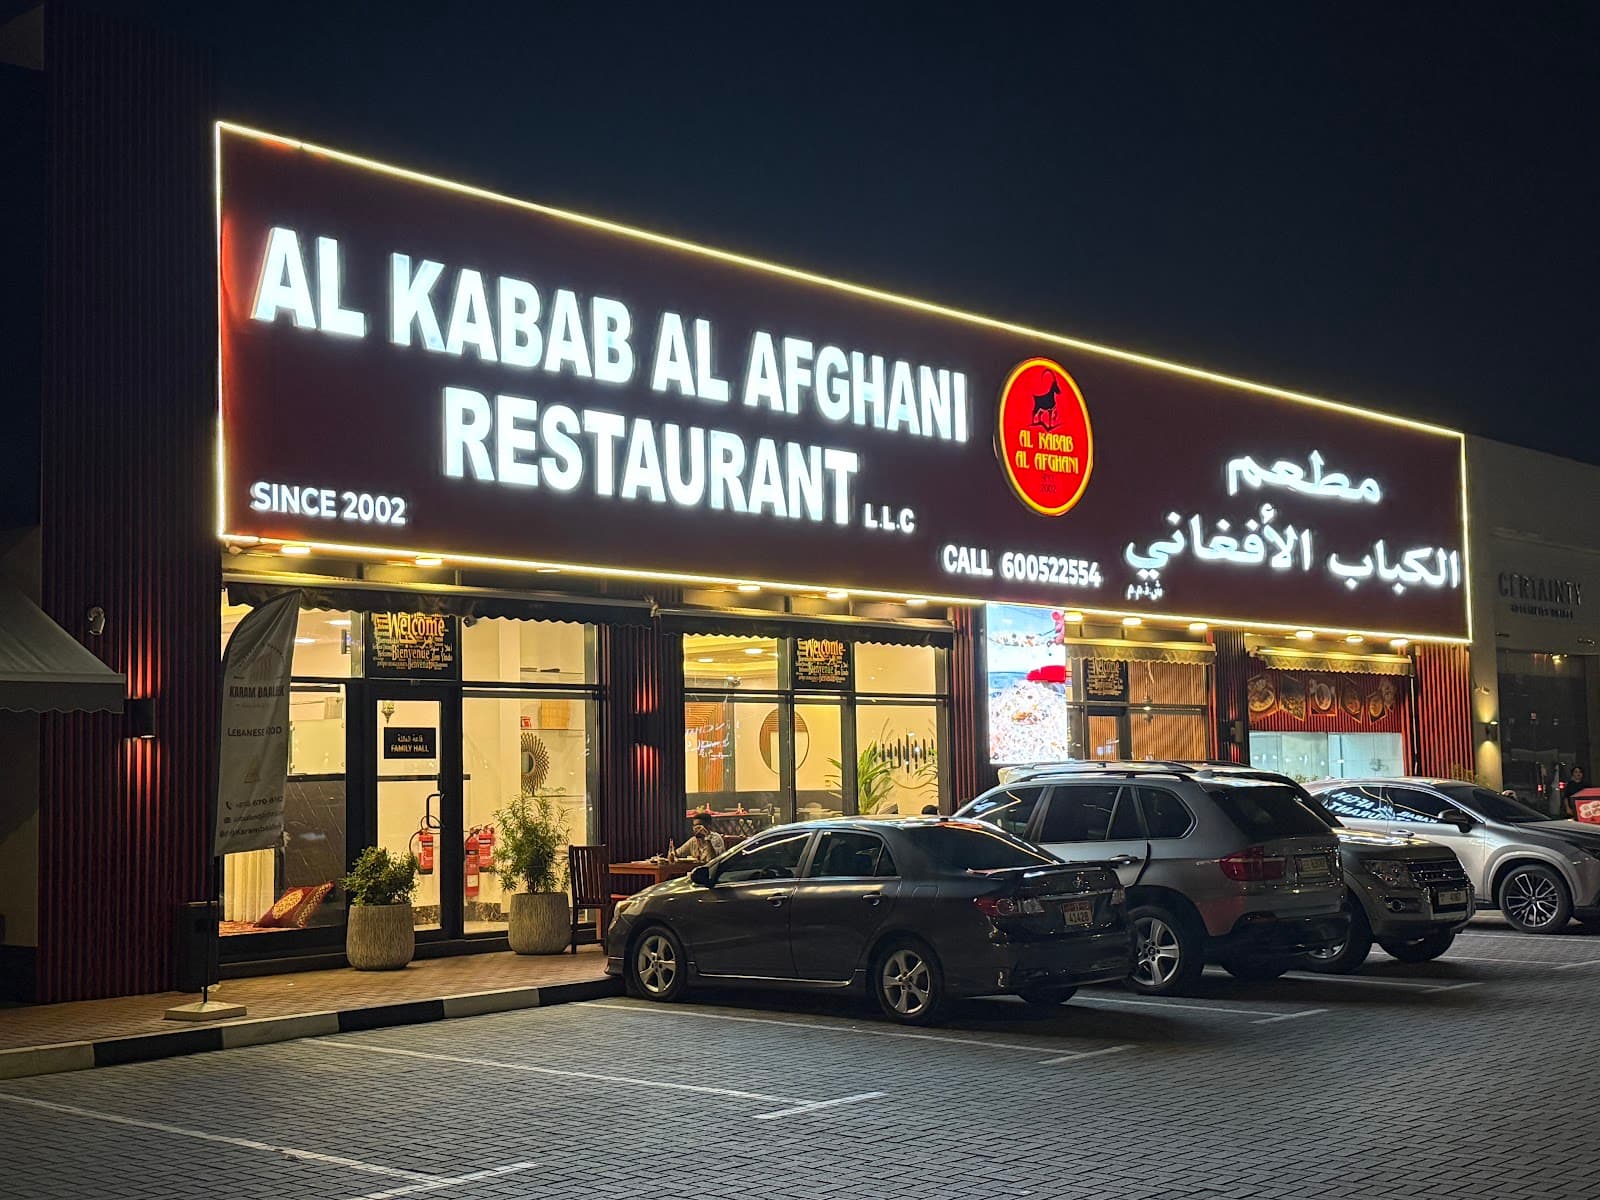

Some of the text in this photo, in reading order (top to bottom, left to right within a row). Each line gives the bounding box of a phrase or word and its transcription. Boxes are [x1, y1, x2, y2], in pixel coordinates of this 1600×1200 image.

[250, 226, 969, 442] AL KABAB AL AFGHANI
[442, 386, 859, 526] RESTAURANT
[1019, 430, 1074, 453] AL KABAB
[1015, 450, 1079, 474] AL AFGHANI
[1226, 450, 1382, 504] مطعم
[250, 481, 407, 525] SINCE 2002
[864, 502, 915, 533] L.L.C
[943, 544, 1102, 587] CALL 600522554
[1125, 503, 1458, 594] الكباب الأفغاني
[1498, 572, 1581, 606] CERTAINTY
[387, 612, 445, 645] Welcome
[227, 727, 265, 737] LEBANESE
[391, 744, 430, 753] FAMILY HALL
